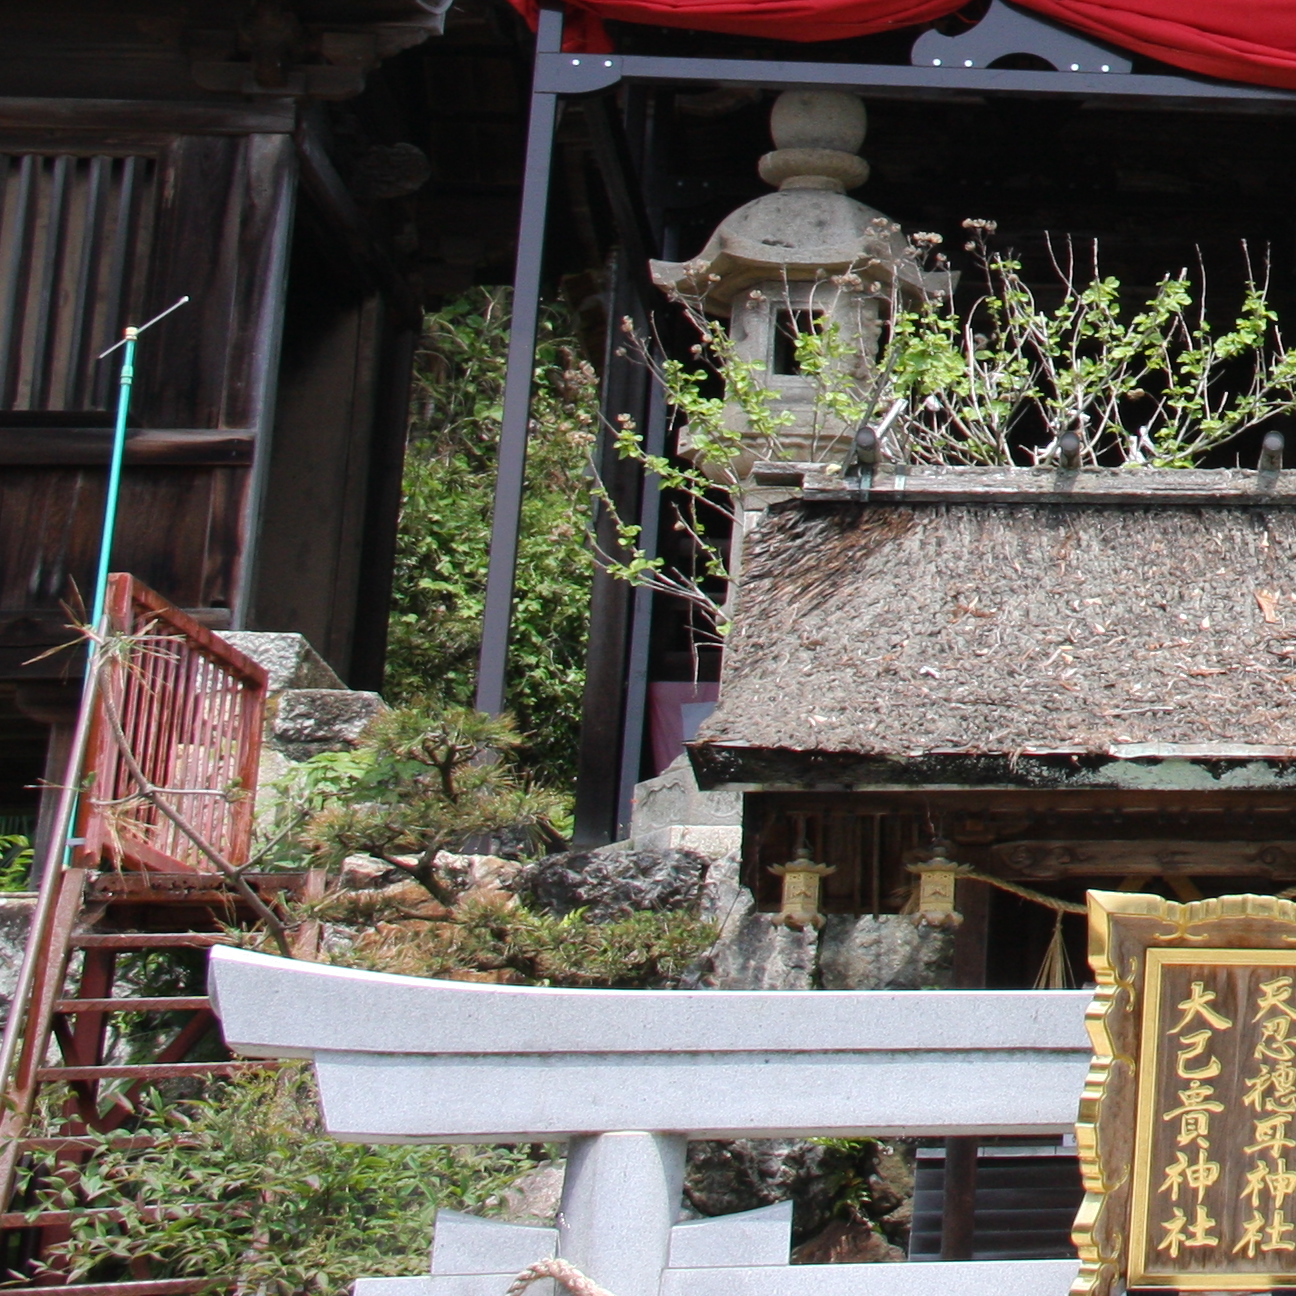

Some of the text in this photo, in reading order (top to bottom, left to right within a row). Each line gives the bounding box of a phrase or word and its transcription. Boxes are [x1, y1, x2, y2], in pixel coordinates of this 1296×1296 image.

[1157, 982, 1232, 1258] 大己貴神社
